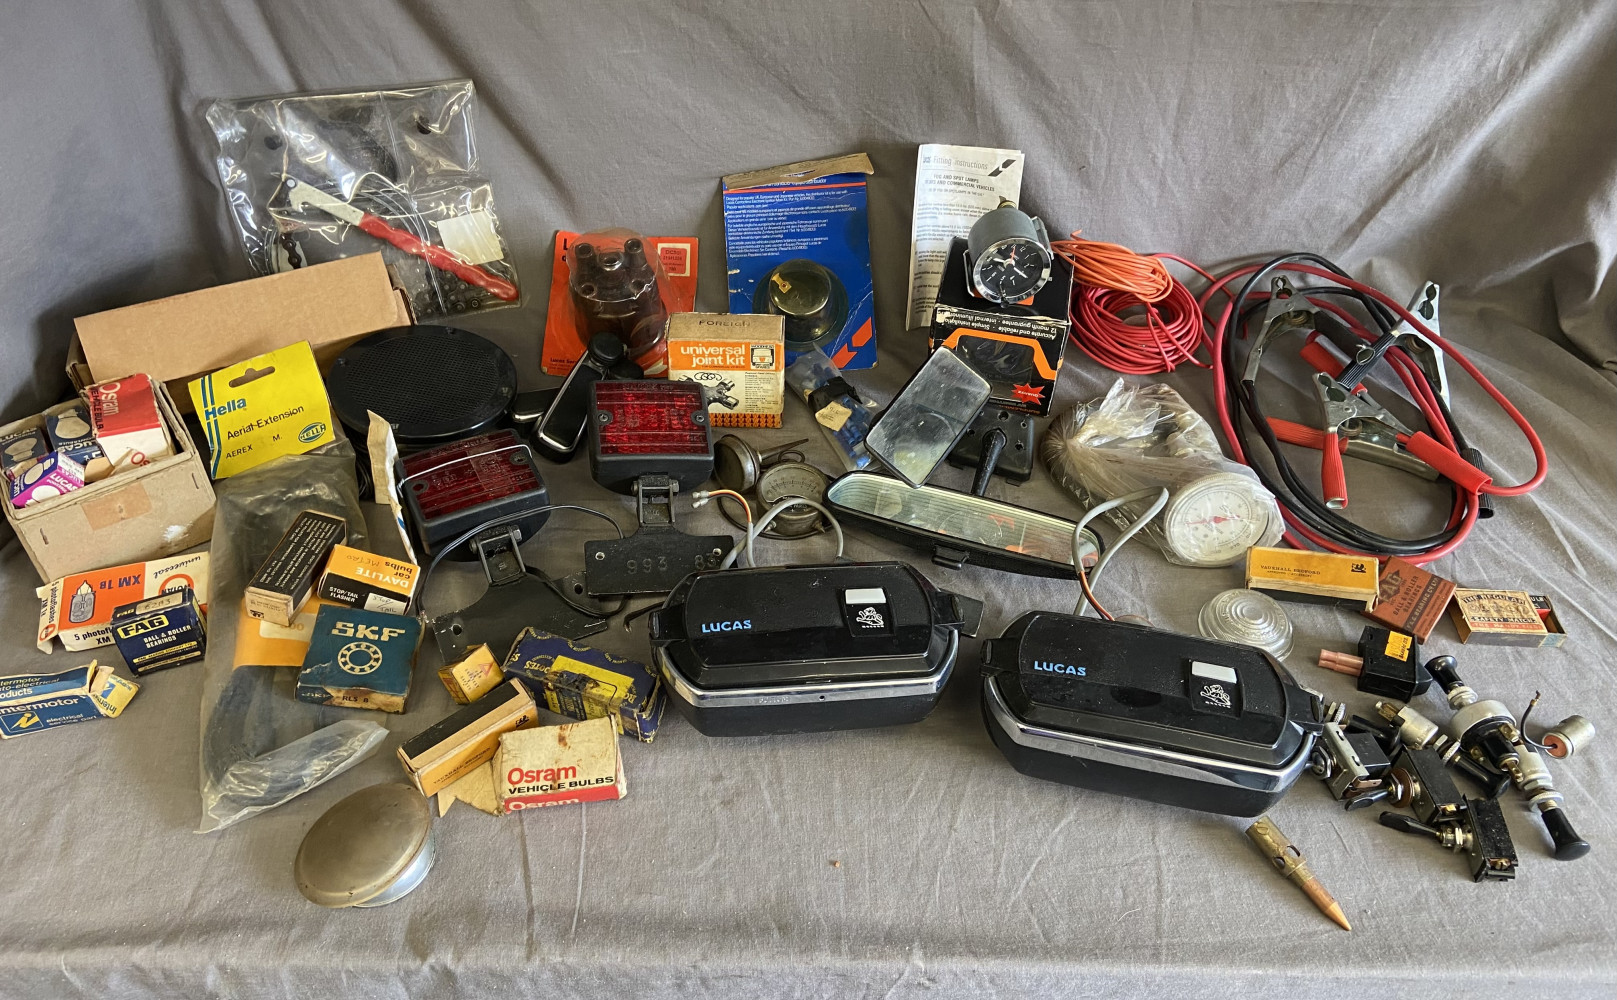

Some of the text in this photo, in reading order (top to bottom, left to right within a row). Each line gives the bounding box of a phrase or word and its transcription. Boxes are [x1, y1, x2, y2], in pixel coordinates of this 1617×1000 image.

[1032, 331, 1056, 340] Accurate
[680, 344, 745, 356] universal
[692, 354, 745, 368] joint kit
[100, 382, 120, 416] Osram
[204, 398, 246, 420] Hella
[227, 406, 304, 440] Aerial-Extension
[300, 423, 326, 440] HELLA
[226, 445, 253, 460] AEREX
[50, 473, 78, 490] LUCAS
[153, 556, 202, 579] universal
[385, 562, 413, 573] bulbs
[1260, 564, 1290, 574] VAUXHALL
[100, 574, 142, 590] XM 1B
[356, 566, 410, 588] DAYLITE
[329, 586, 358, 599] STOP/TAIL
[330, 592, 356, 602] FLASHER
[74, 627, 114, 642] 5 photofl
[122, 618, 166, 636] FAG
[144, 635, 159, 644] BALL
[169, 625, 192, 636] ROLLER
[332, 620, 406, 642] SKF
[702, 620, 752, 634] LUCAS
[96, 636, 112, 645] XM
[146, 636, 177, 649] BEARINGS
[1034, 660, 1086, 676] LUCAS
[0, 677, 42, 688] termotor
[0, 687, 32, 699] oducts
[47, 713, 84, 724] electrical
[507, 766, 576, 786] Osram
[508, 776, 614, 795] VEHICLE BULBS
